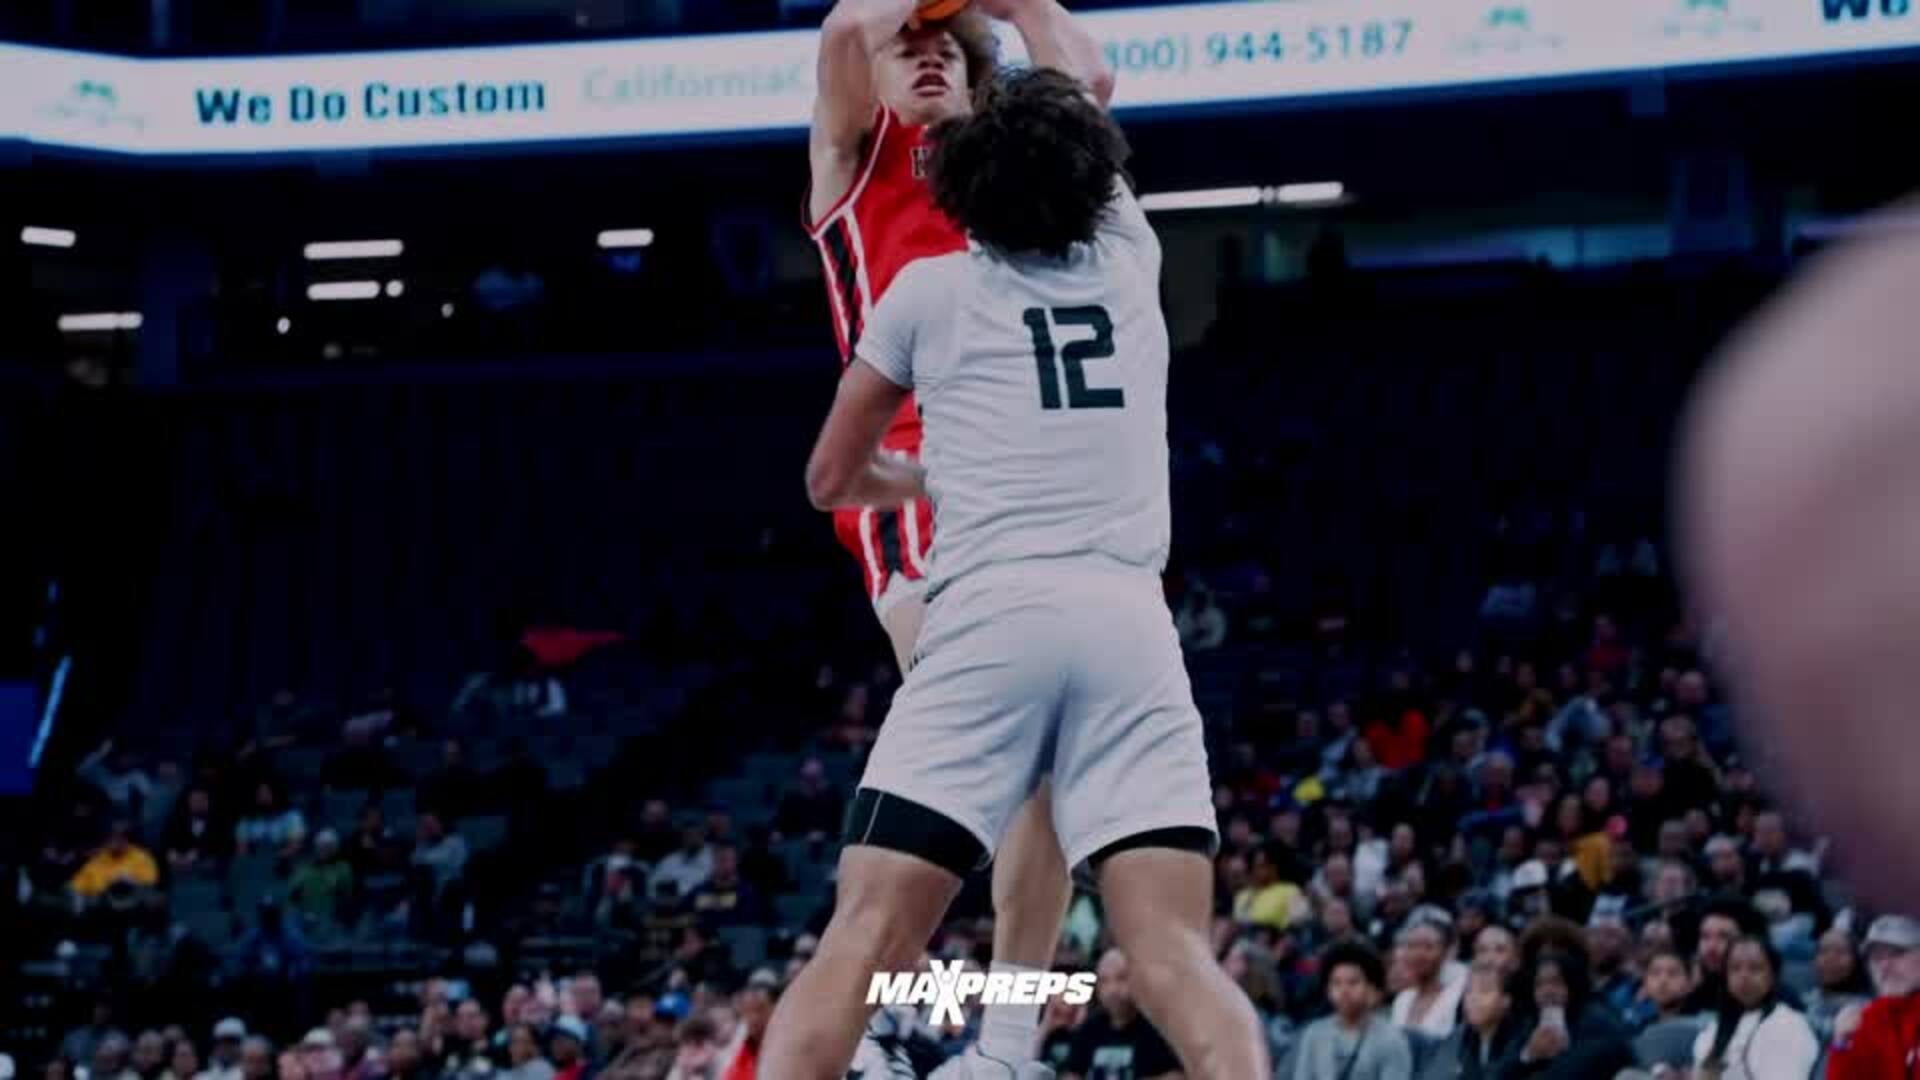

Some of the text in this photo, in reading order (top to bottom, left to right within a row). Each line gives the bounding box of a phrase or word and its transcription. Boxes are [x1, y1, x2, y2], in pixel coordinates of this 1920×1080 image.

[195, 86, 272, 124] We
[289, 85, 347, 122] Do
[363, 81, 545, 120] Custom
[1022, 304, 1125, 410] 12
